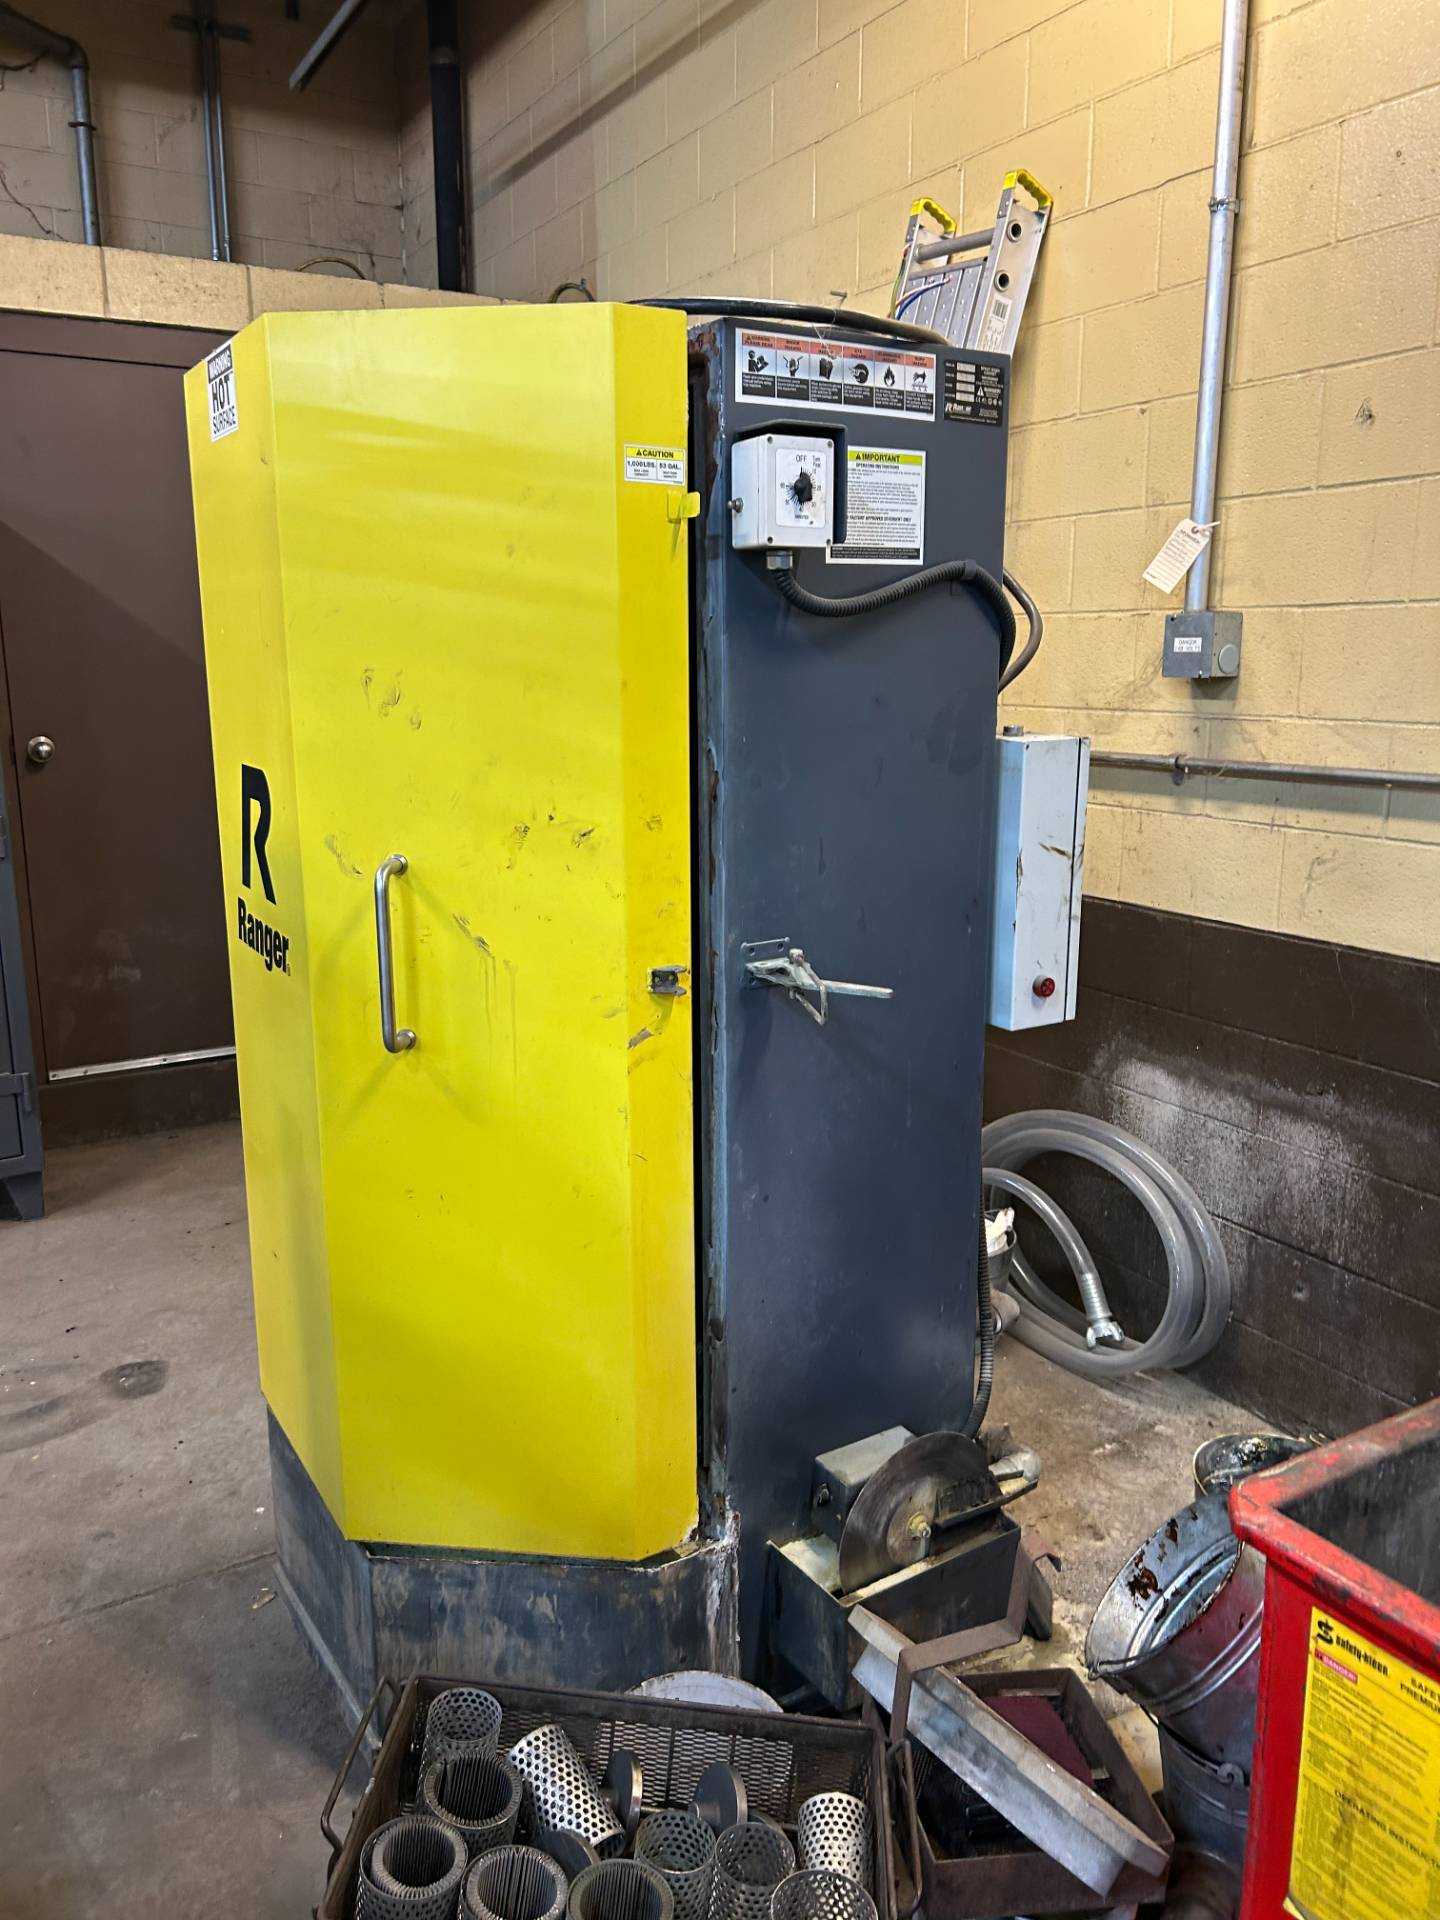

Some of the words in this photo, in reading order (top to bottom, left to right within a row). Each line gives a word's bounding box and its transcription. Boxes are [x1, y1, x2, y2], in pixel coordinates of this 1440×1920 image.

[207, 349, 232, 379] WARNING
[211, 372, 233, 414] HOT
[212, 404, 236, 435] SURFACE
[642, 449, 674, 459] CAUTION
[862, 453, 900, 463] IMPORTANT
[237, 896, 290, 972] Ranger
